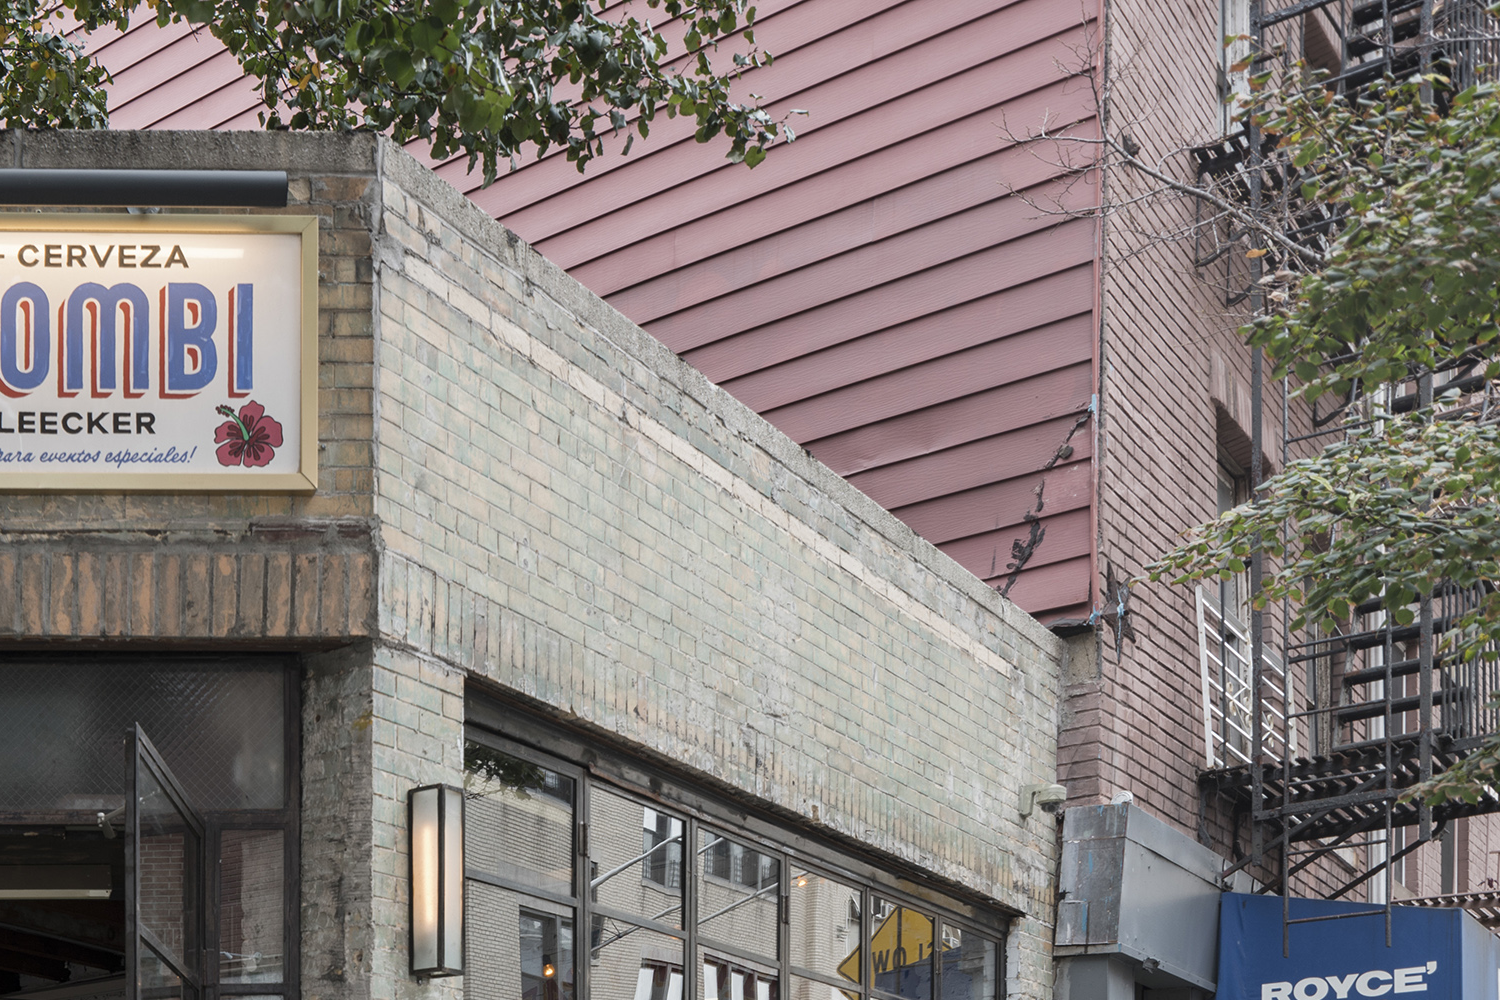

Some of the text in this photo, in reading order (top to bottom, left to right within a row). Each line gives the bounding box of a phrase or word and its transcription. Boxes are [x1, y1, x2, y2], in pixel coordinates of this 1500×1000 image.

[17, 244, 190, 269] CERVEZA
[39, 449, 101, 464] eventos
[104, 446, 197, 468] especiales!
